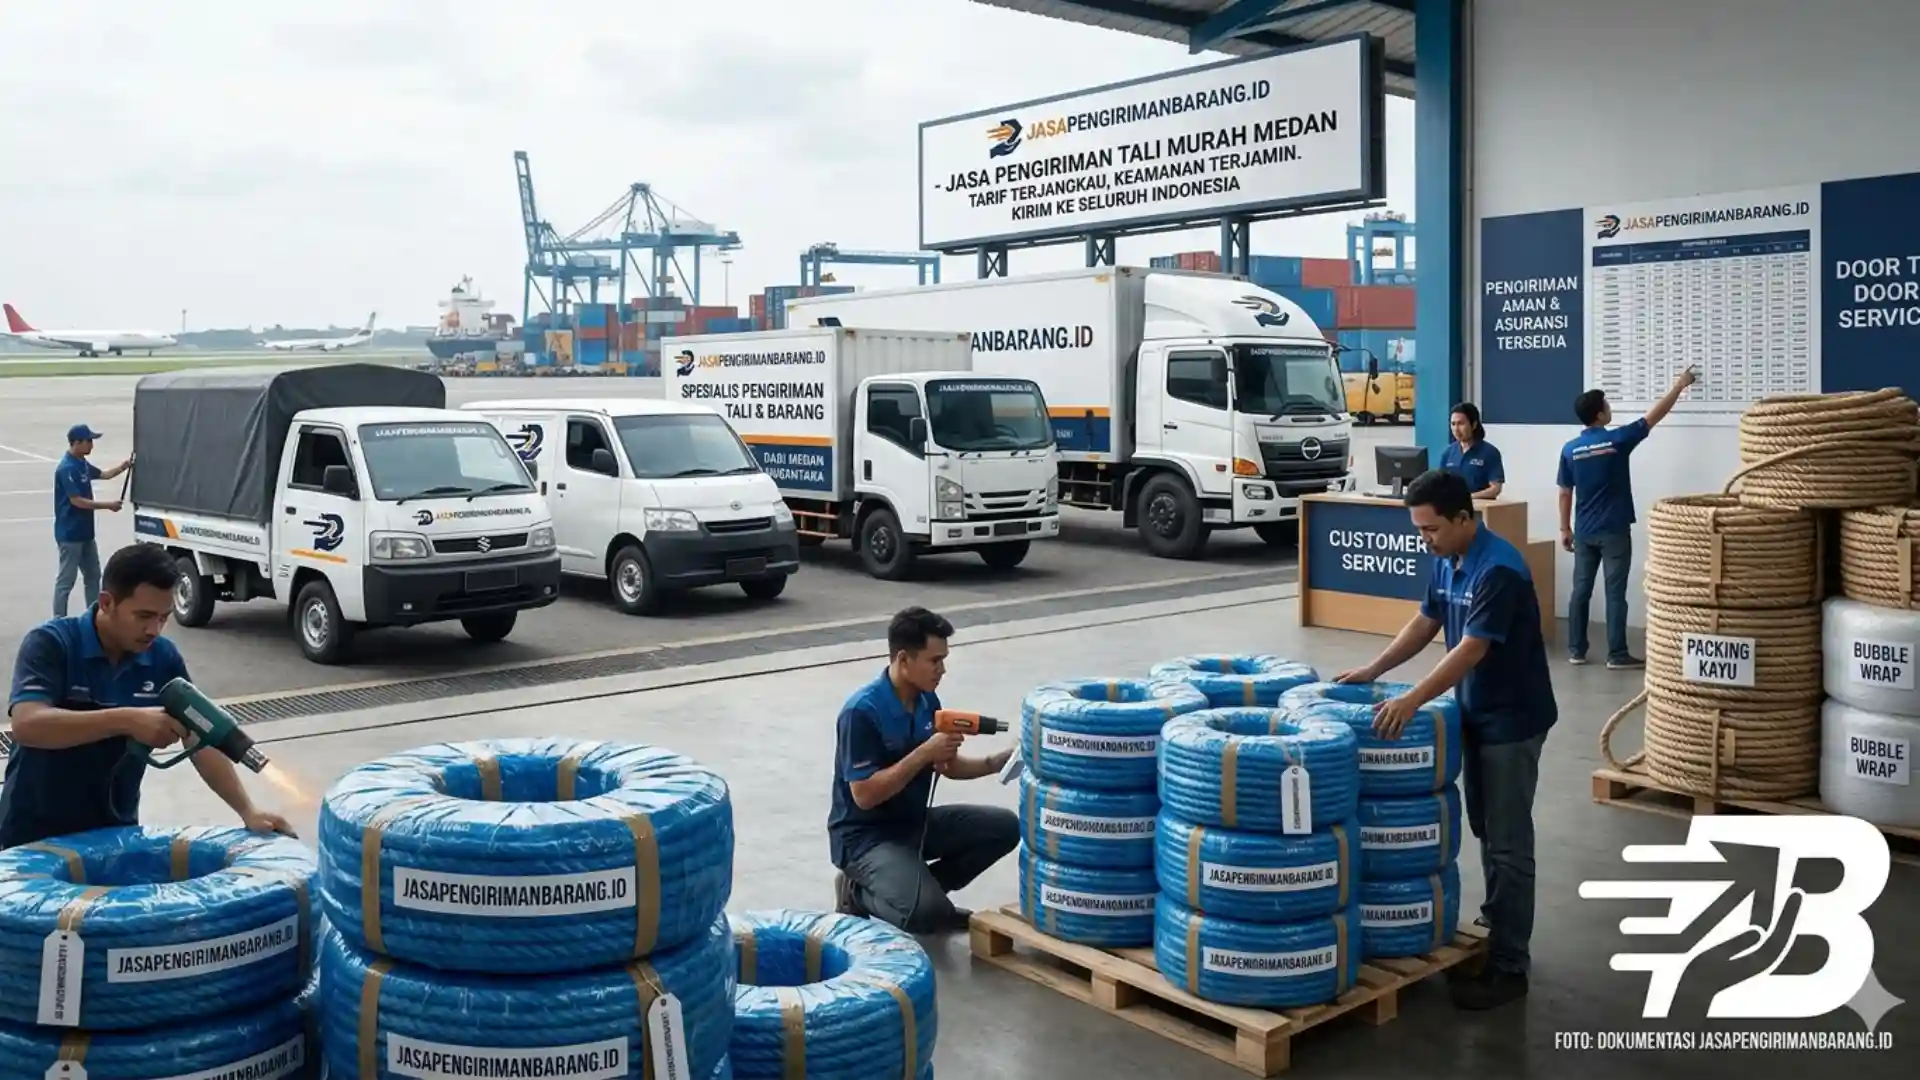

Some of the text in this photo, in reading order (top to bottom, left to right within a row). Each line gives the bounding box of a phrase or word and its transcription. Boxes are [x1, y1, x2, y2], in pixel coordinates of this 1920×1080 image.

[1026, 80, 1271, 140] JASAPENGIRIMANBARANG.ID
[945, 169, 991, 192] JASA
[996, 148, 1113, 184] PENGIRIMAN
[1118, 140, 1161, 164] TALI
[1167, 125, 1247, 157] MURAH
[1254, 110, 1338, 143] MEDAN
[969, 145, 1303, 208] TARIF TERJANGKAU, KEAMANAN TERJAMIN.
[1012, 175, 1241, 220] KIRIM KE SELURUH INDONESIA
[1836, 255, 1920, 279] DOOR T
[1854, 281, 1919, 303] DOOR
[1502, 296, 1561, 312] AMAN &
[1494, 315, 1569, 332] ASURANSI
[1838, 306, 1920, 328] SERVIC
[971, 325, 1094, 352] ANBARANG.ID
[1496, 334, 1567, 350] TERSEDIA
[681, 382, 825, 399] SPESIALIS PENGIRIMAN
[725, 403, 825, 420] TALI & BARANG
[1329, 530, 1428, 554] CUSTOMER
[1342, 553, 1417, 576] SERVICE
[1687, 638, 1750, 660] PACKING
[1854, 642, 1909, 664] BUBBLE
[1699, 660, 1738, 680] KAYU
[1860, 663, 1902, 683] WRAP
[1850, 736, 1905, 760] BUBBLE
[1856, 758, 1897, 778] WRAP
[396, 1045, 619, 1077] JASAPENGIRIMANBARANG.ID
